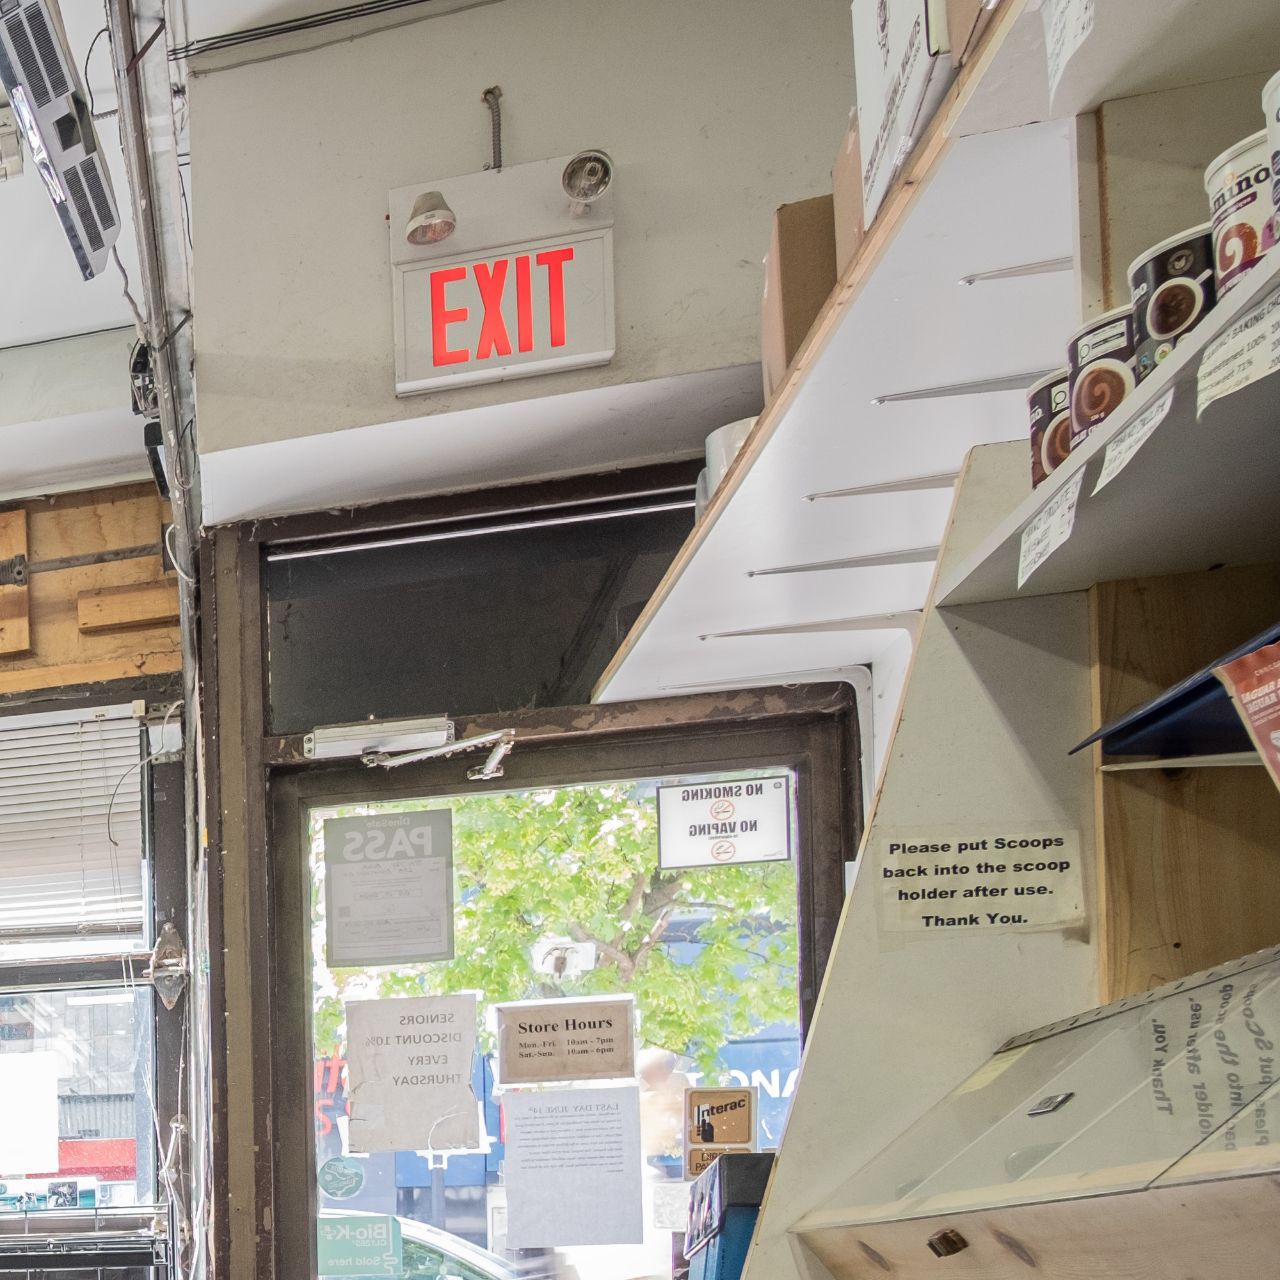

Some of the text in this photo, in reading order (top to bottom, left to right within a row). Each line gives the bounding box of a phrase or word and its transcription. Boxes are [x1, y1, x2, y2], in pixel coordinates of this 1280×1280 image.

[430, 247, 574, 367] EXIT
[888, 834, 1065, 856] Please put Scoops
[882, 858, 1071, 879] back into the scoop
[897, 883, 1054, 902] holder after use.
[922, 911, 1028, 928] Thank You.
[518, 1018, 613, 1035] Store Hours
[567, 1036, 614, 1046] 10am 7pm
[567, 1046, 614, 1056] 10am 6pm
[697, 1098, 746, 1126] Interac
